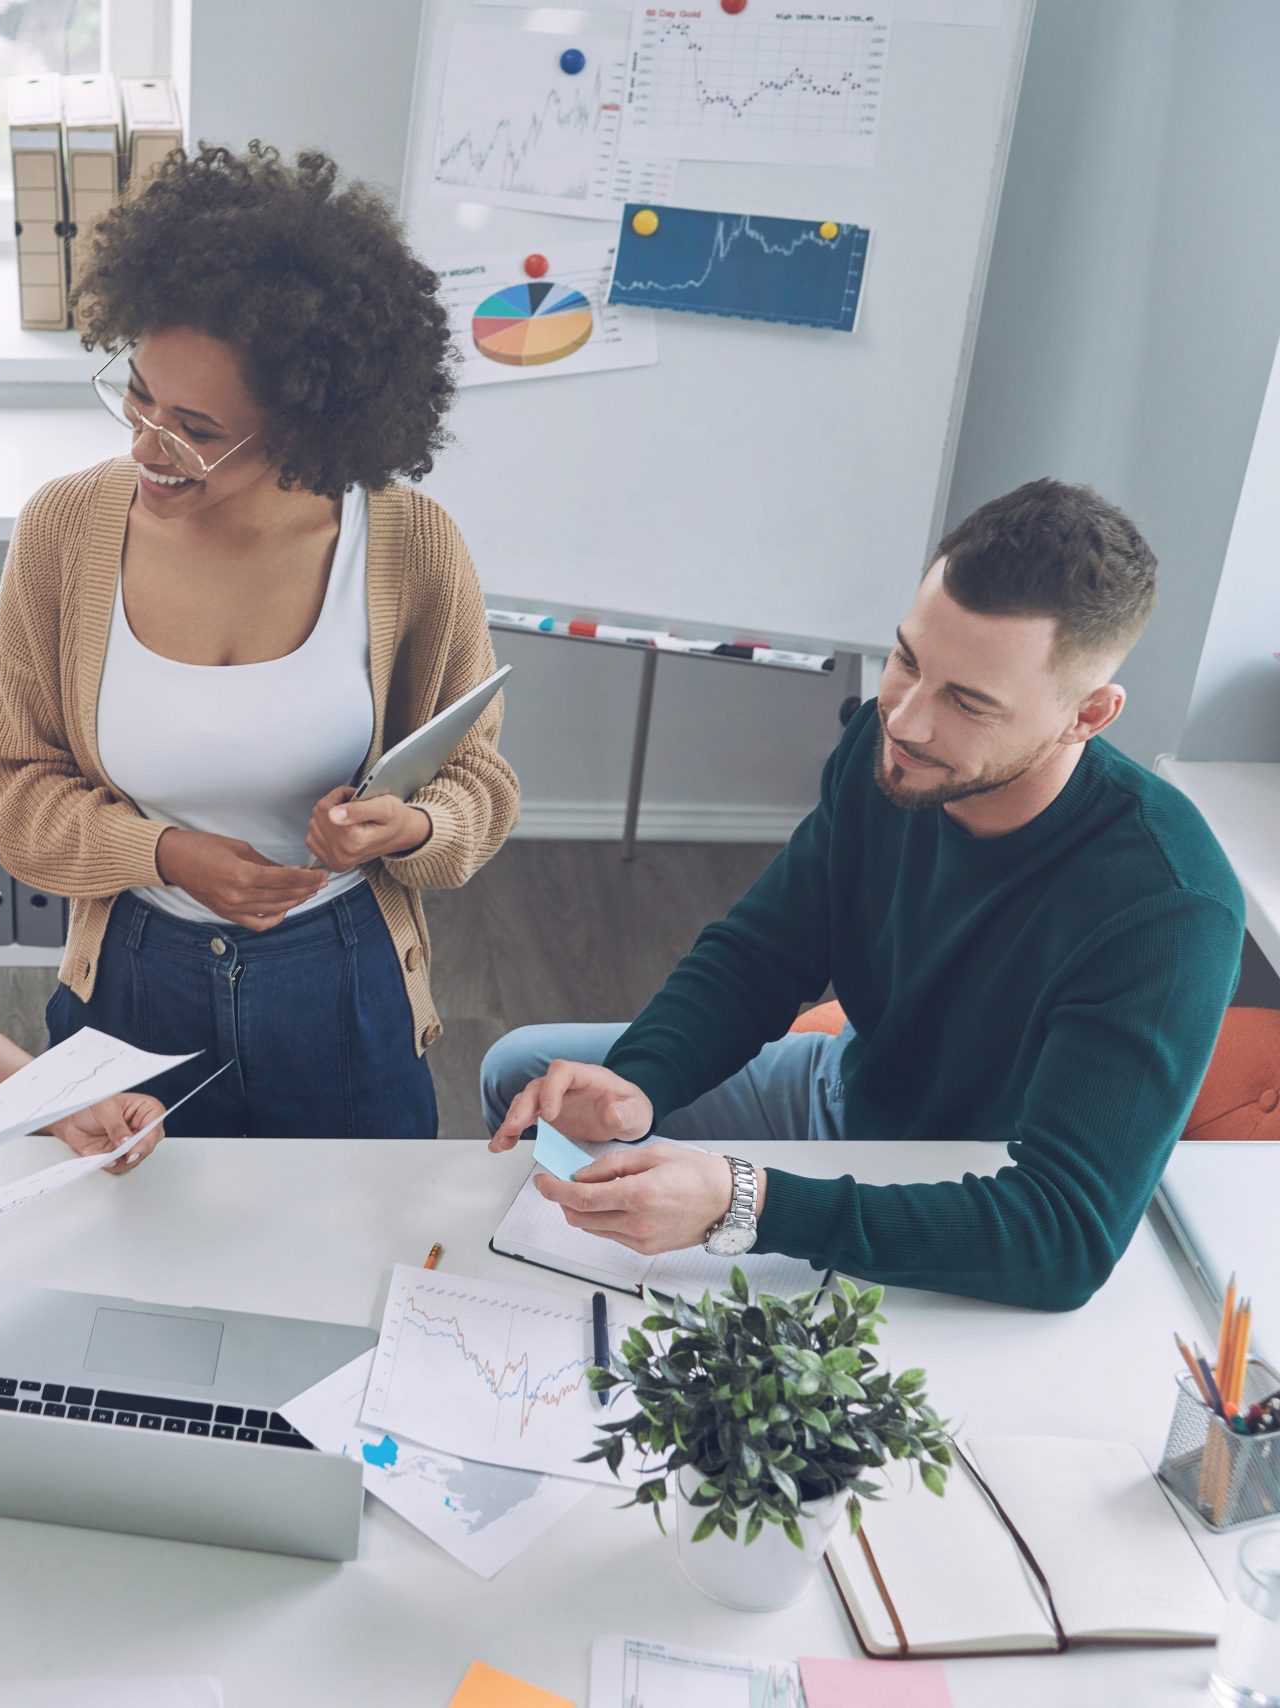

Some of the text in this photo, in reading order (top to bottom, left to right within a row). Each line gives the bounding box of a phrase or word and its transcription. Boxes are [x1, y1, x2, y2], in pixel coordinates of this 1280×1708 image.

[658, 9, 676, 19] Day
[679, 10, 702, 18] Gold
[449, 266, 486, 278] WEIGHTS
